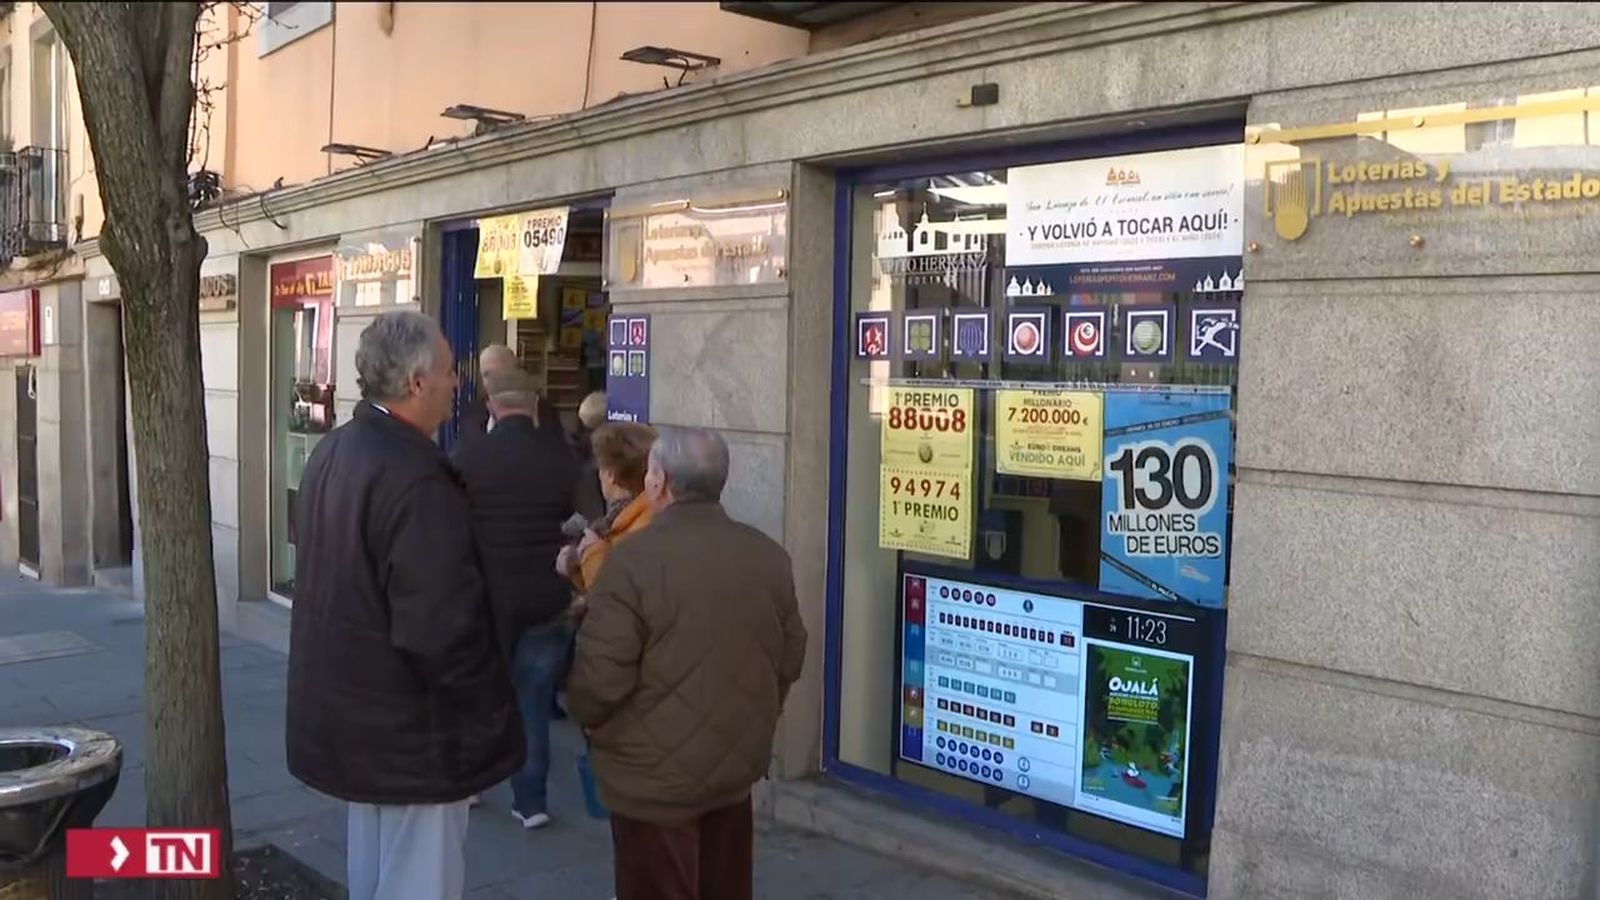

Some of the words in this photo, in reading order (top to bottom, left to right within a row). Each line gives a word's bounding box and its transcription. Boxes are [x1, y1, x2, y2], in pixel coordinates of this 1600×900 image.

[1328, 159, 1427, 184] Loterías
[1435, 159, 1452, 181] y
[1328, 188, 1443, 217] Apuestas
[1453, 178, 1492, 207] del
[1500, 171, 1600, 203] Estado
[1027, 224, 1038, 242] Y
[1041, 216, 1098, 241] VOLVIÓ
[1101, 220, 1113, 237] A
[1117, 215, 1174, 237] TOCAR
[1178, 208, 1229, 233] AQUÍ!
[524, 227, 564, 248] 05490
[904, 393, 959, 408] PREMIO
[1022, 398, 1073, 409] MILLONARIO
[888, 406, 966, 433] 88008
[1008, 407, 1081, 426] 7.200.000
[1010, 451, 1055, 465] VENDIDO
[1058, 454, 1086, 467] AQUÍ
[1110, 444, 1213, 510] 130
[890, 476, 961, 501] 94974
[904, 501, 959, 522] PREMIO
[1109, 513, 1196, 532] MILLONES
[1126, 535, 1151, 553] DE
[1154, 535, 1220, 555] EUROS
[1127, 615, 1167, 645] 11:23
